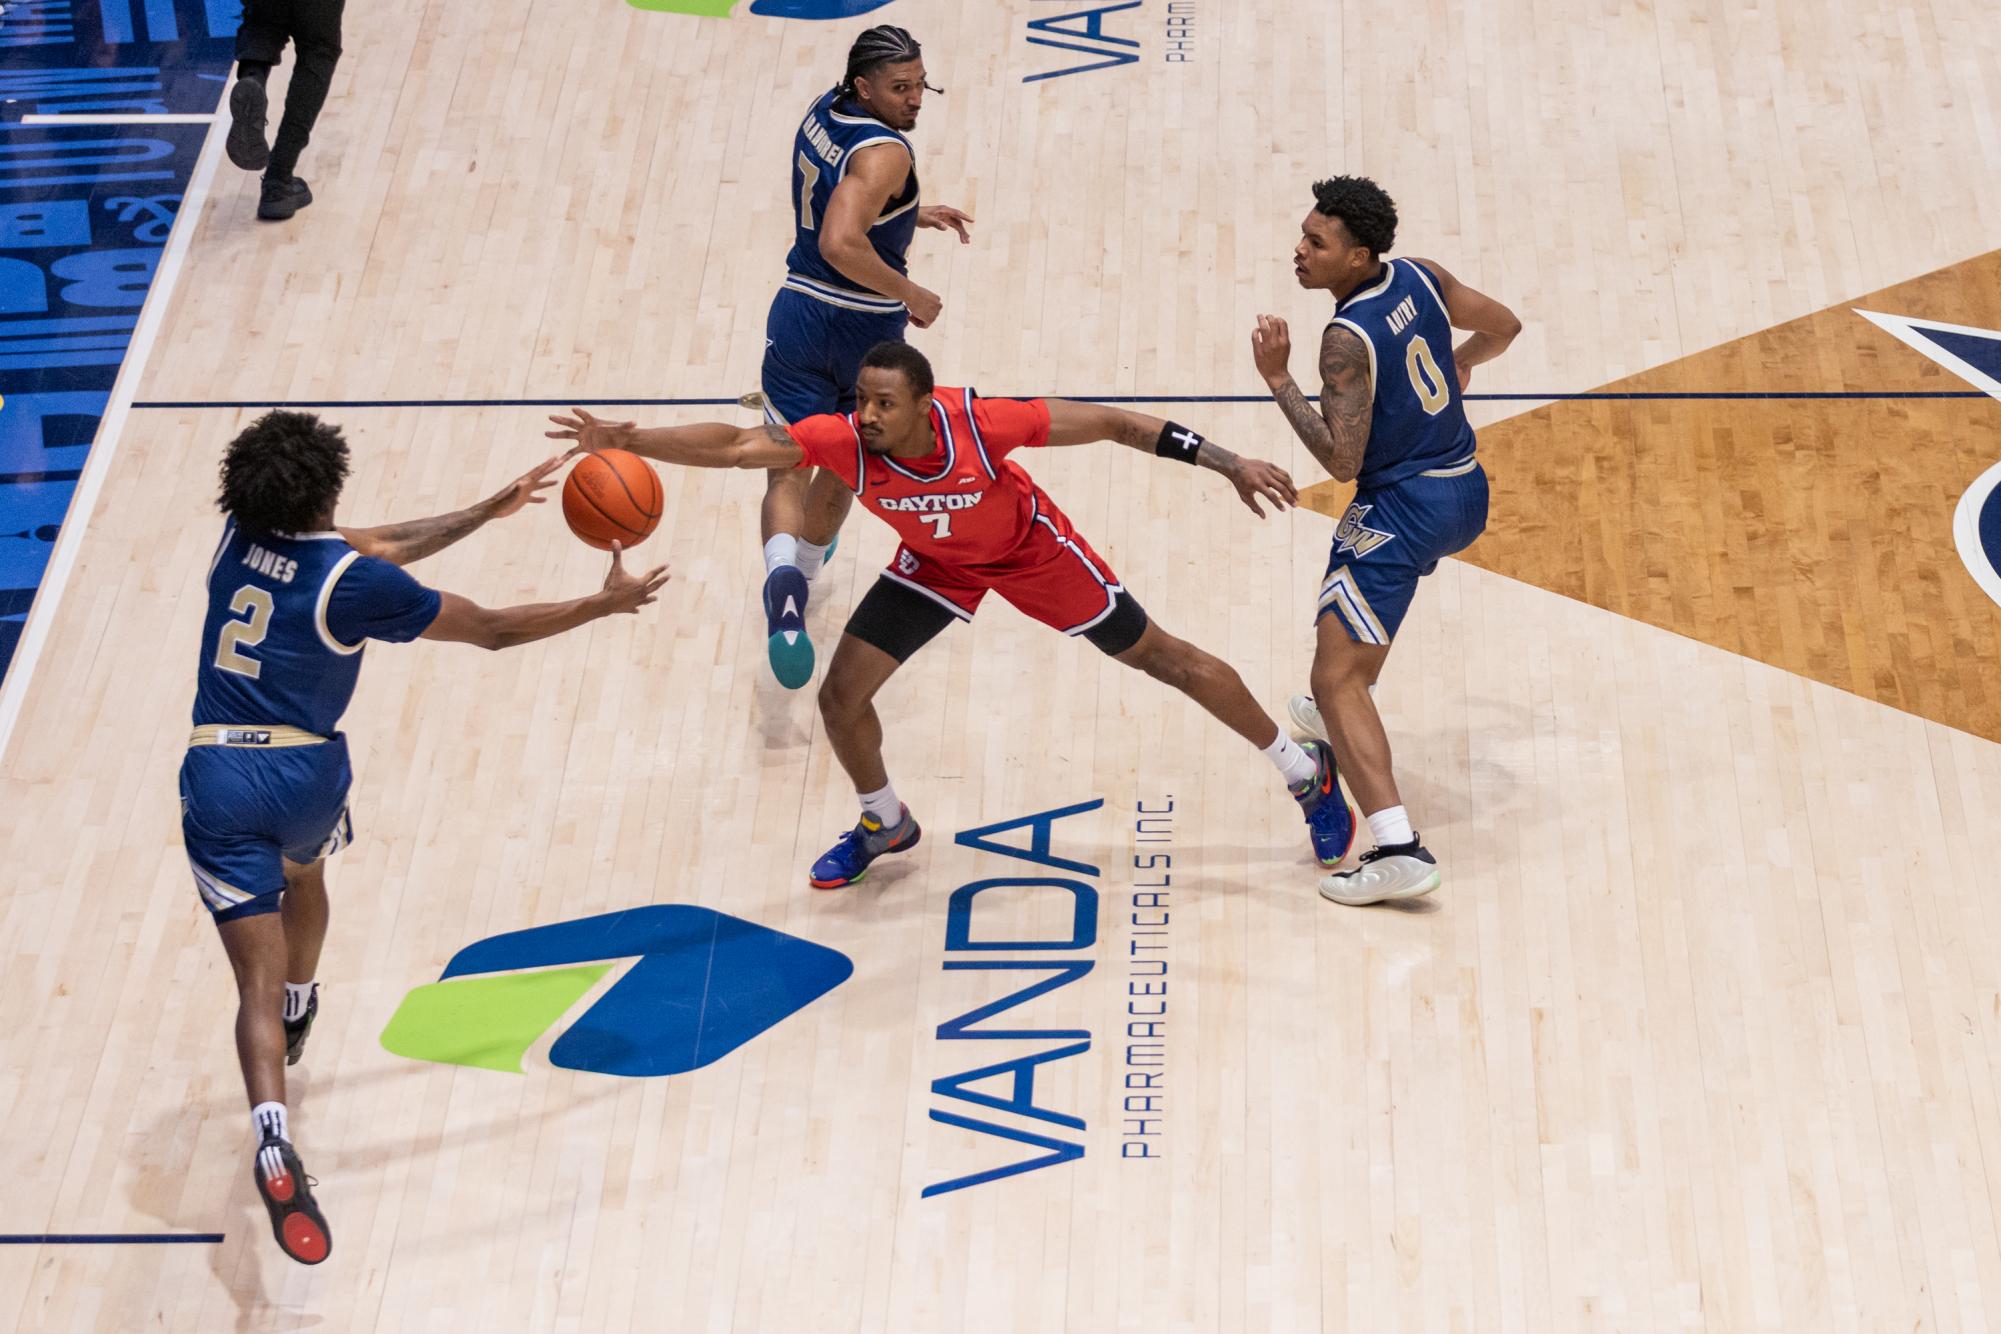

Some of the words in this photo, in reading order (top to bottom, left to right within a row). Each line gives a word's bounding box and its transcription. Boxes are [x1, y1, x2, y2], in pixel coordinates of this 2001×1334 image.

[1385, 294, 1418, 336] AUTRY
[1406, 334, 1449, 416] 0
[877, 490, 984, 511] DAYTON
[919, 512, 952, 539] 7
[241, 543, 299, 584] JONES
[214, 584, 275, 679] 2
[1136, 794, 1174, 842] INC.
[921, 798, 1104, 1199] VANDA
[1122, 854, 1171, 1158] PHARMACEUTICALS
